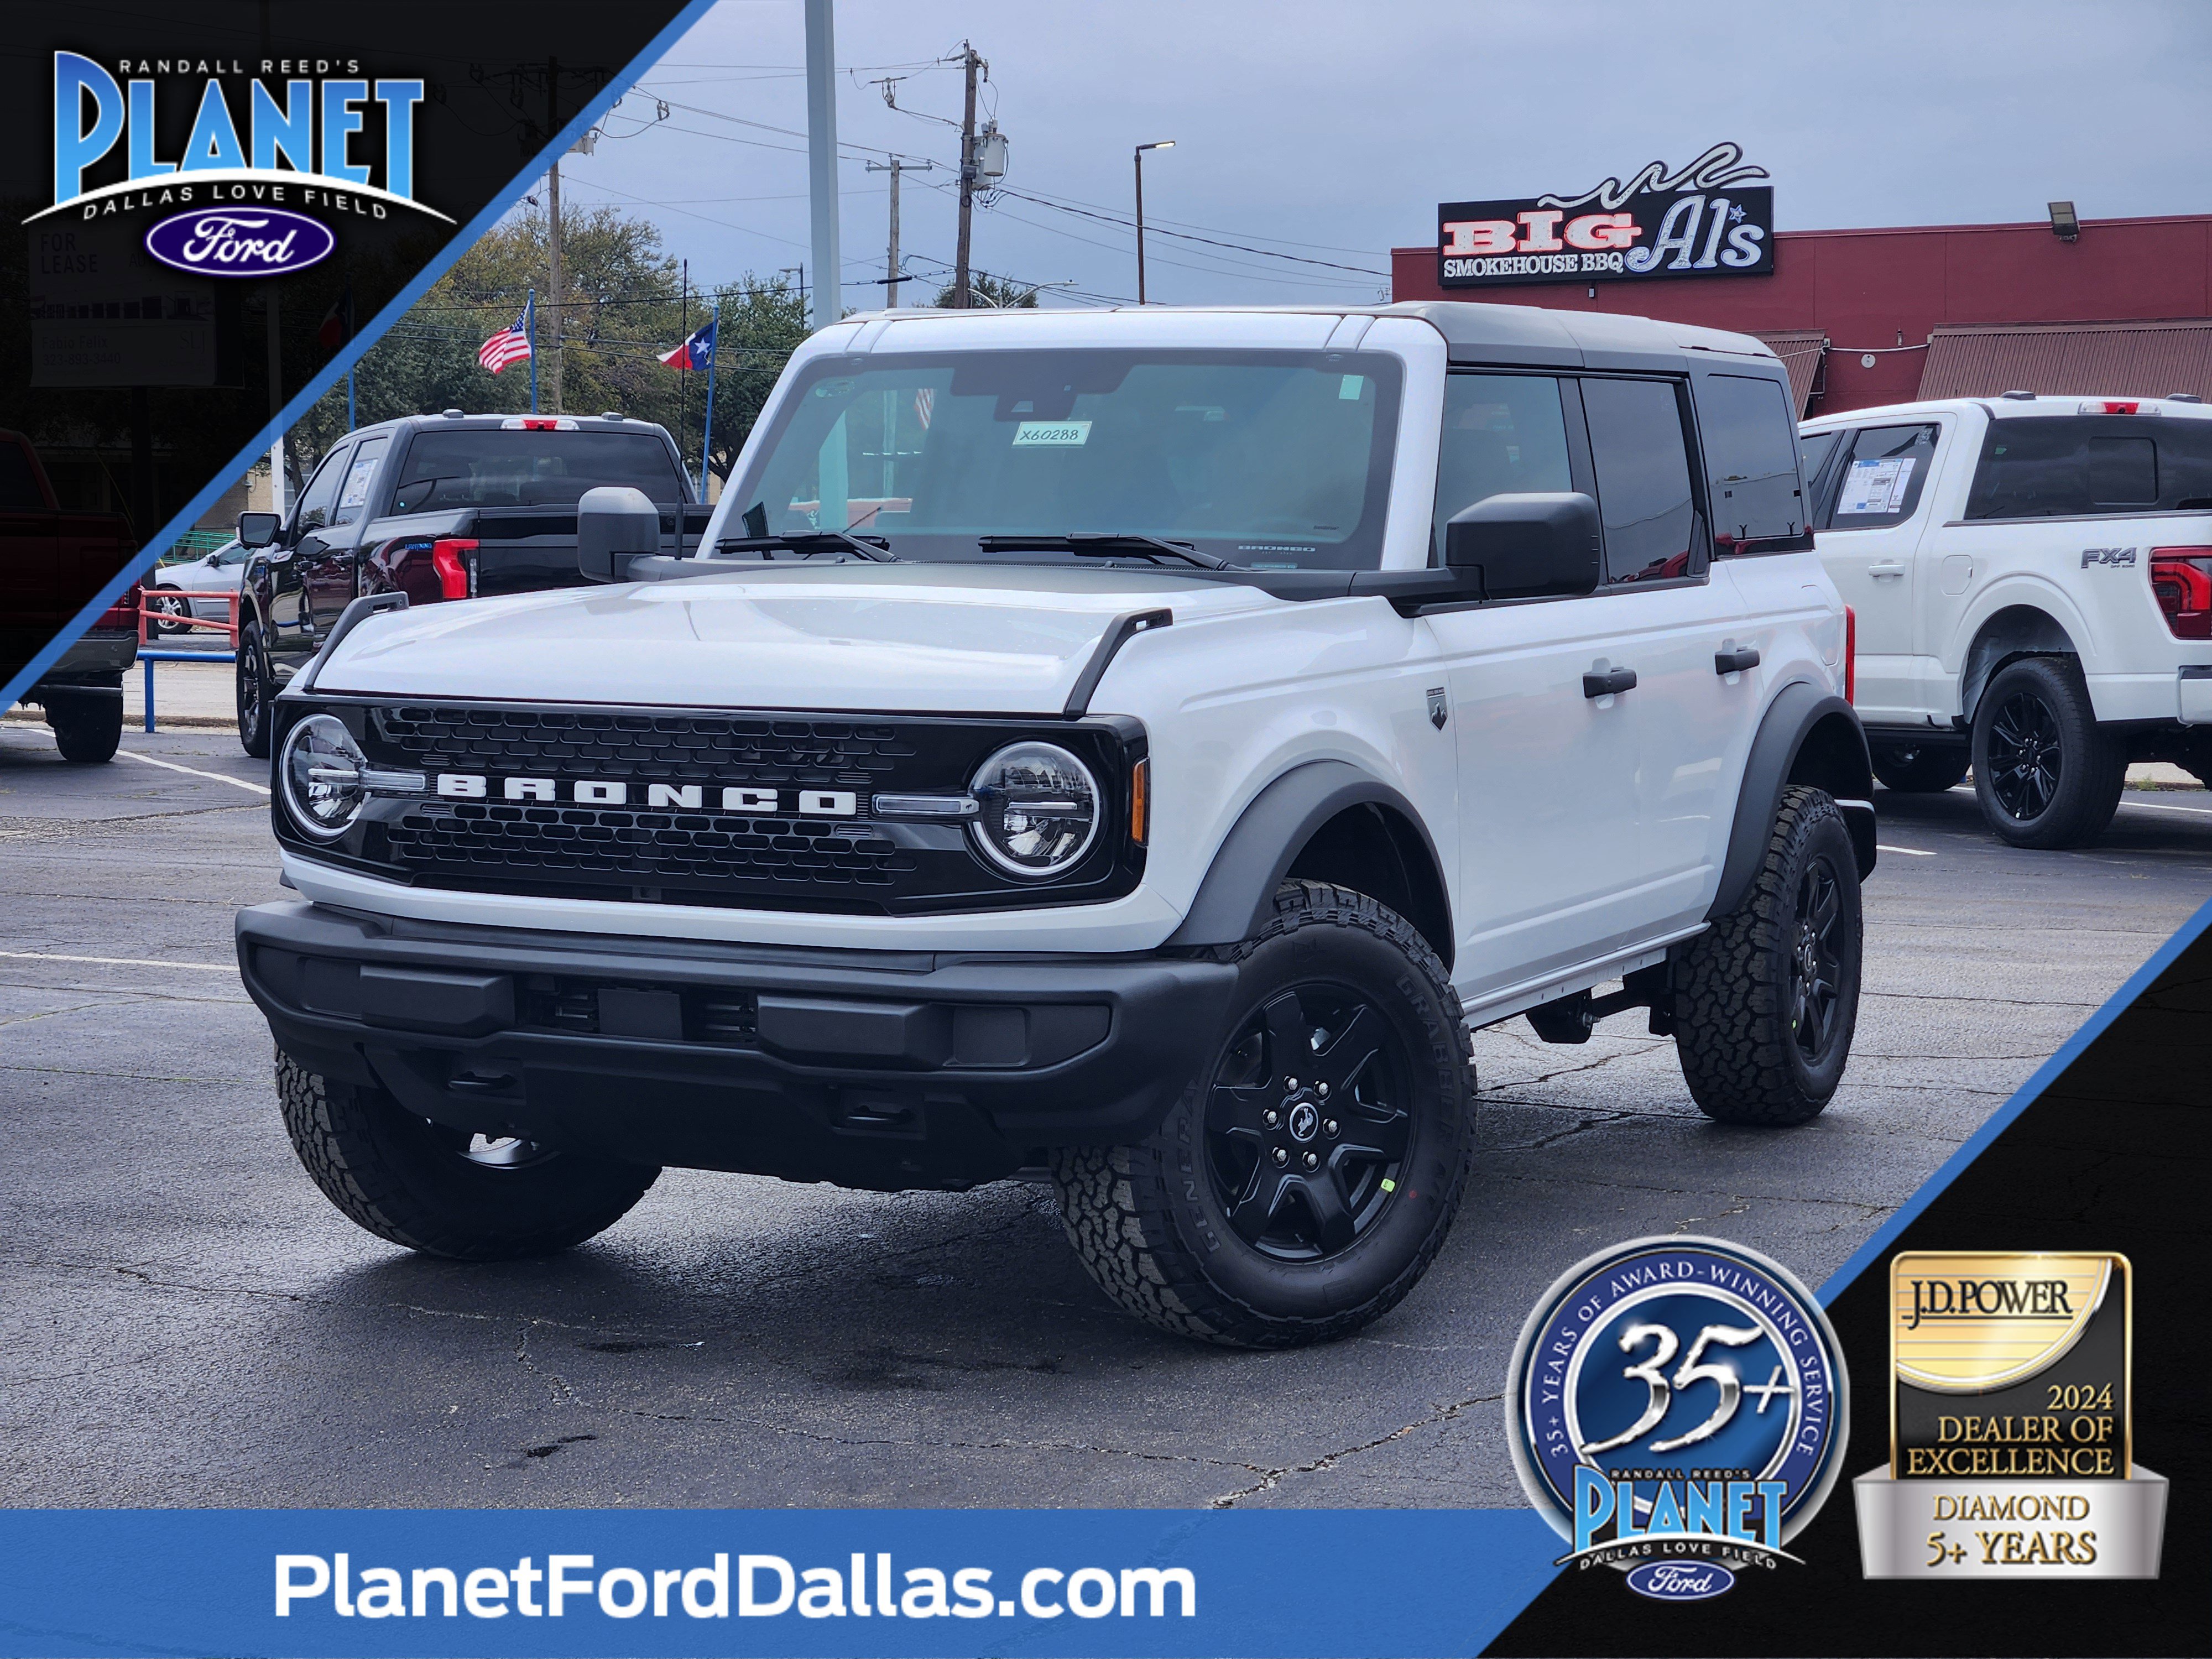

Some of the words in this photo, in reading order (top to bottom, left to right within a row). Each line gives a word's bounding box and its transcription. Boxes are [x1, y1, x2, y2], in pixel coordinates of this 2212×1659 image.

[41, 233, 76, 252] FOR
[1442, 210, 1642, 256] BIG
[1625, 195, 1765, 273] Al's
[41, 254, 98, 274] LEASE
[1443, 254, 1578, 278] SMOKEHOUSE
[1580, 252, 1624, 274] BBQ
[42, 336, 74, 349] Fabio
[80, 335, 108, 348] Felix
[1020, 430, 1078, 441] X60288
[2081, 547, 2137, 568] FX4
[437, 773, 857, 816] BRONCO
[1396, 973, 1454, 1147] GRABBER
[1177, 1079, 1221, 1253] GENERA
